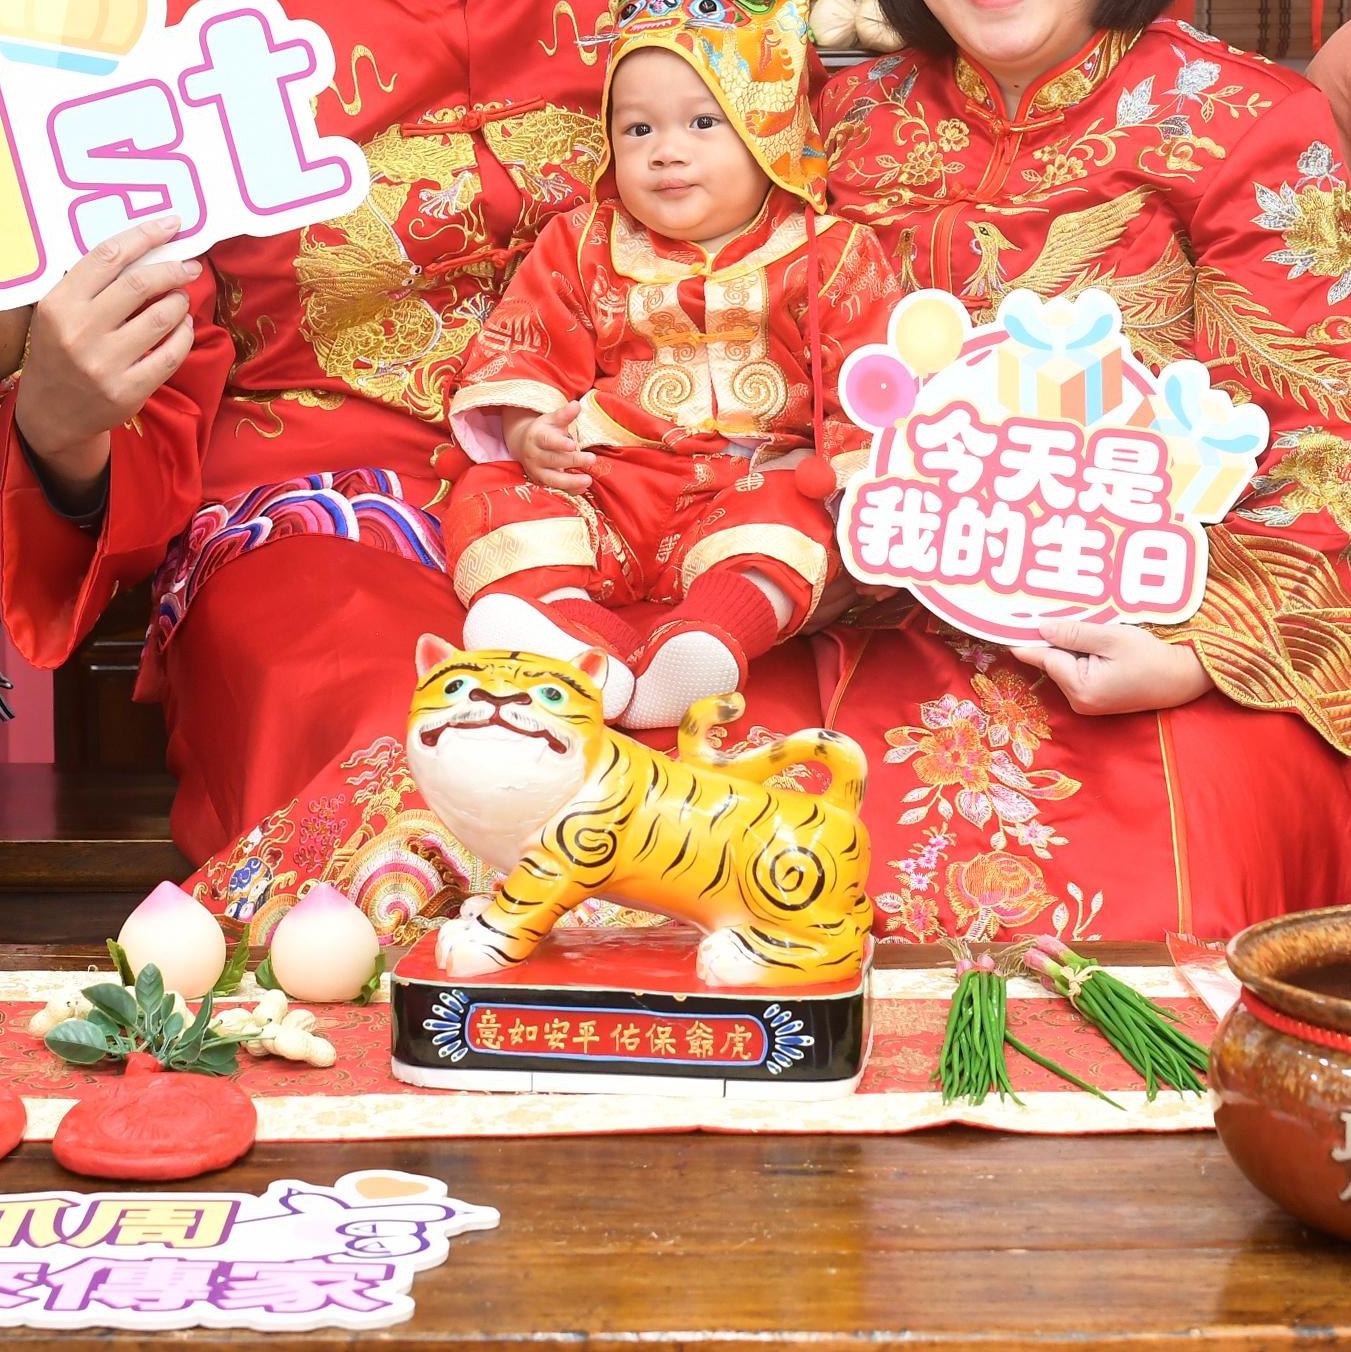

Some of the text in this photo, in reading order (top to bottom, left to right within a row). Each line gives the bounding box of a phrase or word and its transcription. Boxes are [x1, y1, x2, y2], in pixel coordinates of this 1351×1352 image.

[914, 408, 1165, 524] 今天是
[856, 485, 1188, 606] 我的生日
